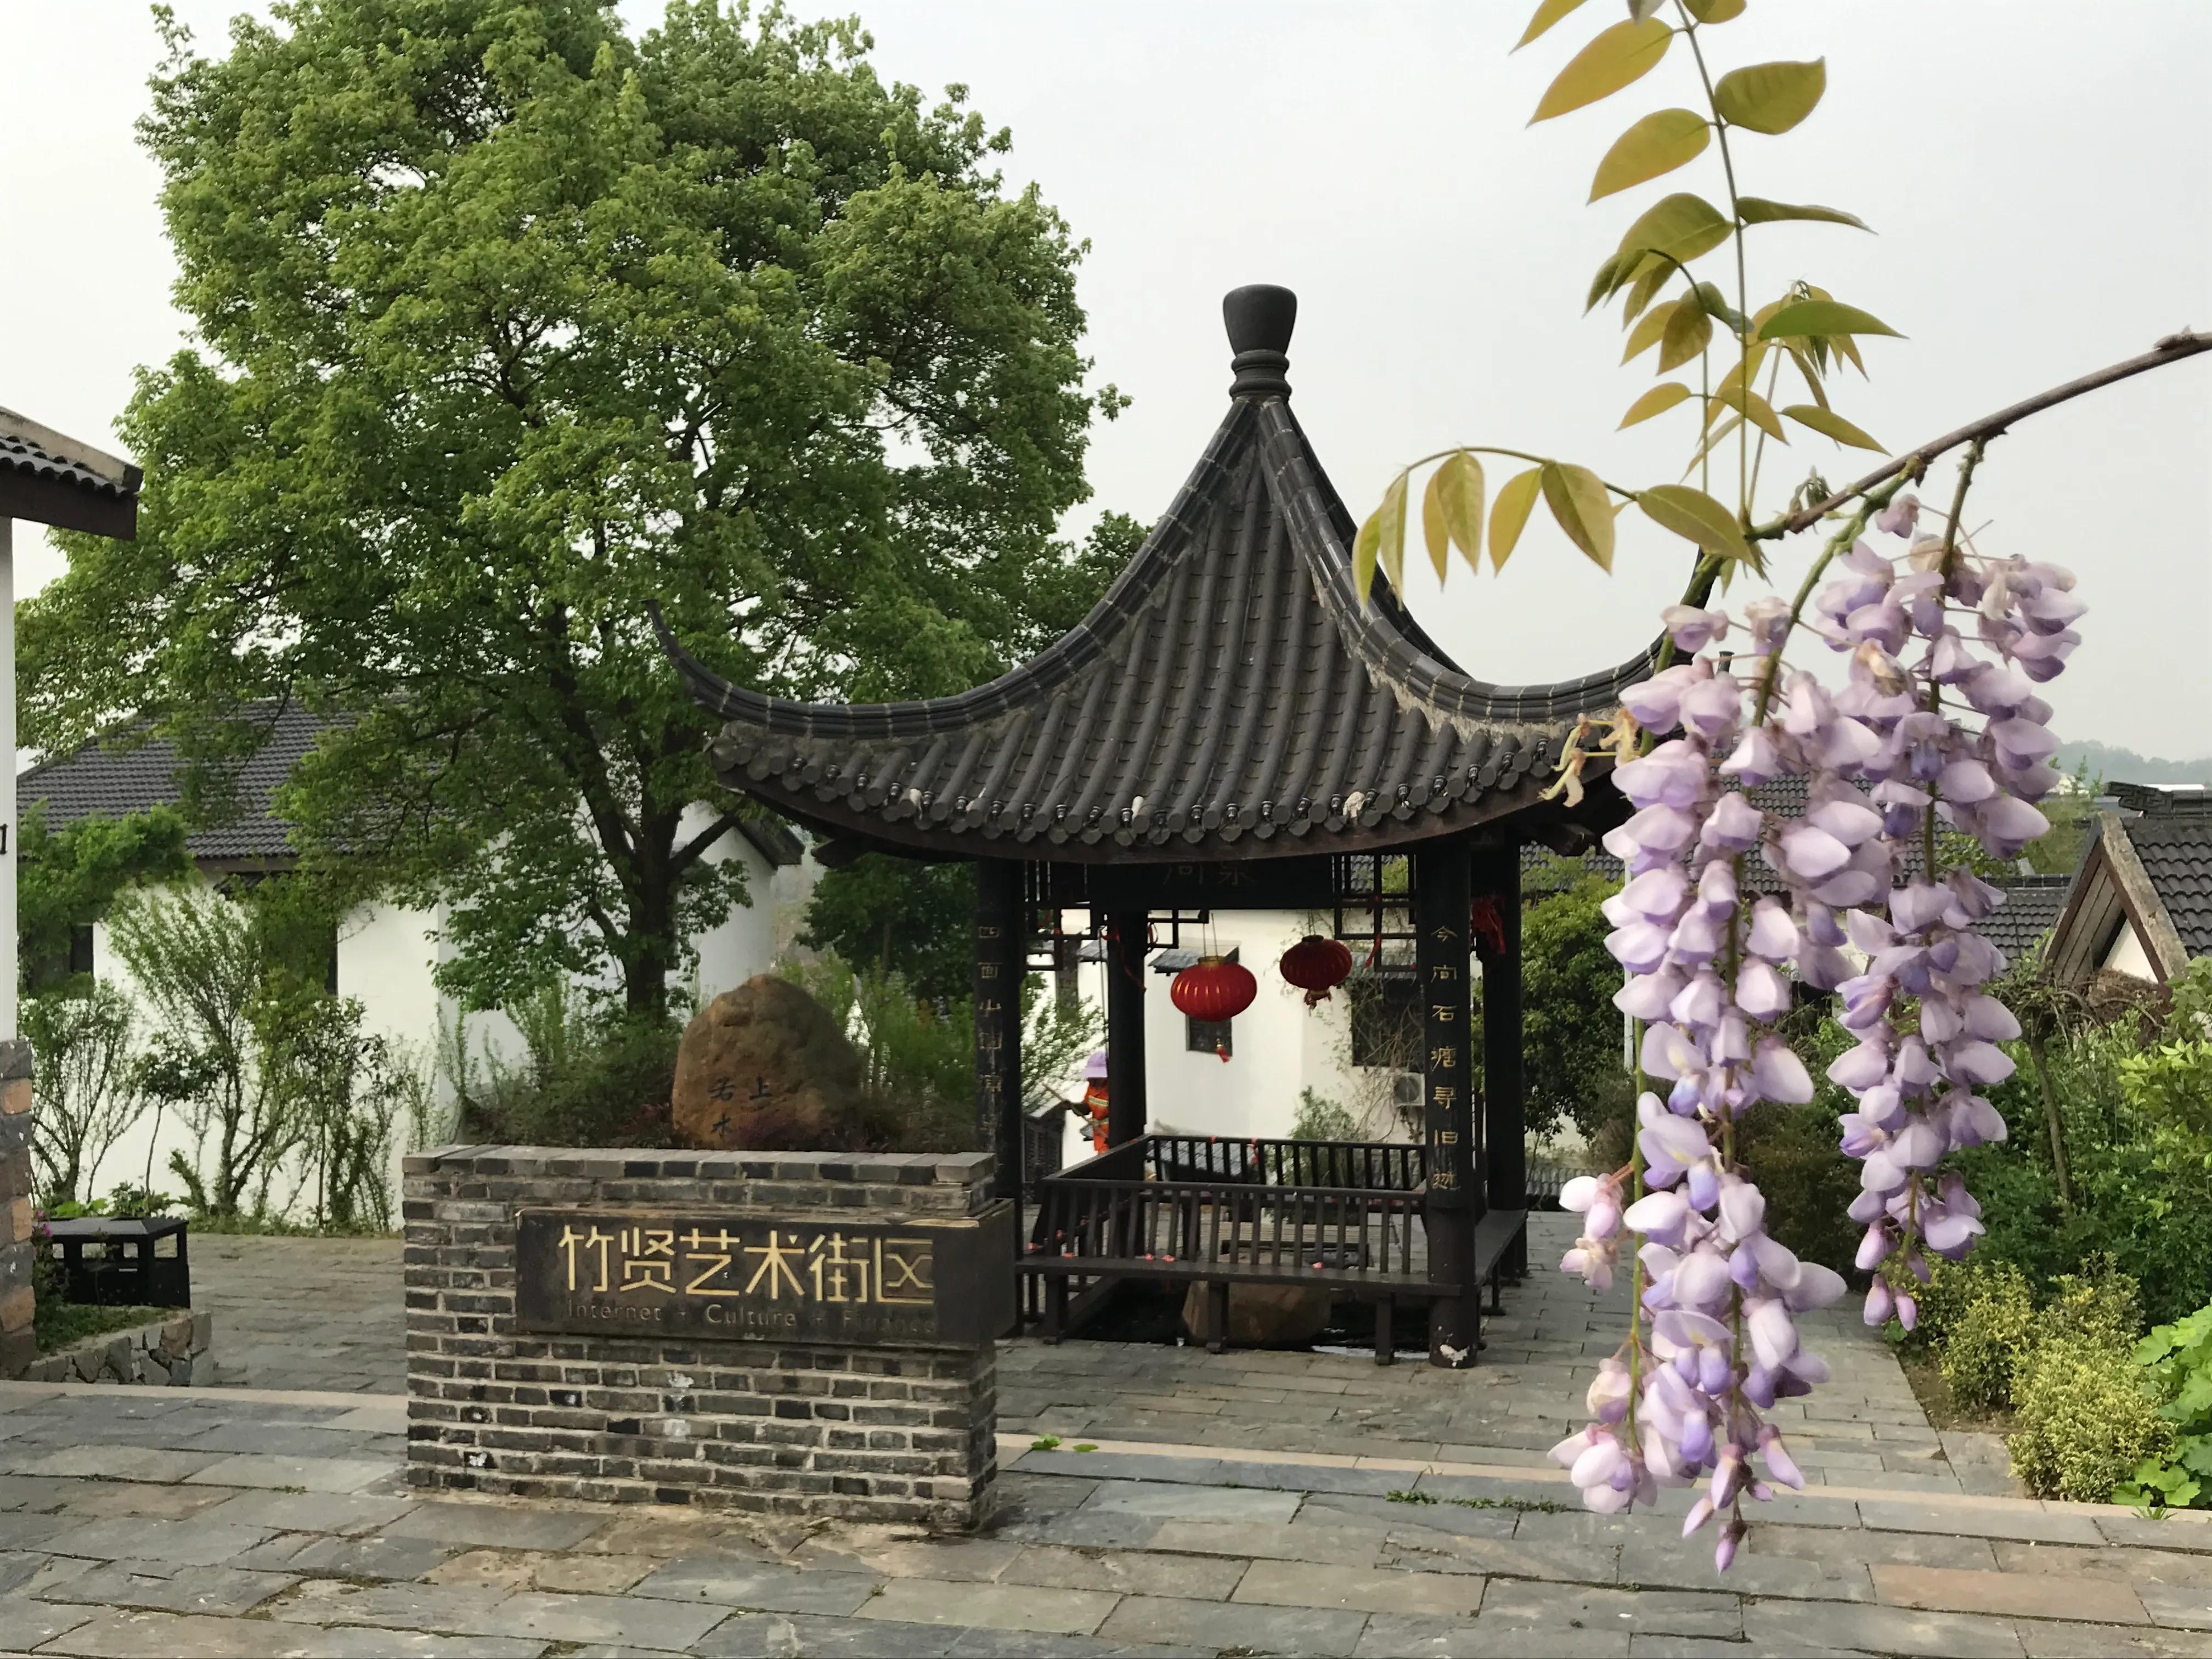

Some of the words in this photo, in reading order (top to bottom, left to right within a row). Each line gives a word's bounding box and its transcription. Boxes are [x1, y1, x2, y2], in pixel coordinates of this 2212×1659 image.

[558, 1224, 934, 1305] 竹贤艺术街区
[567, 1299, 662, 1322] Internet
[706, 1303, 797, 1327] Culture
